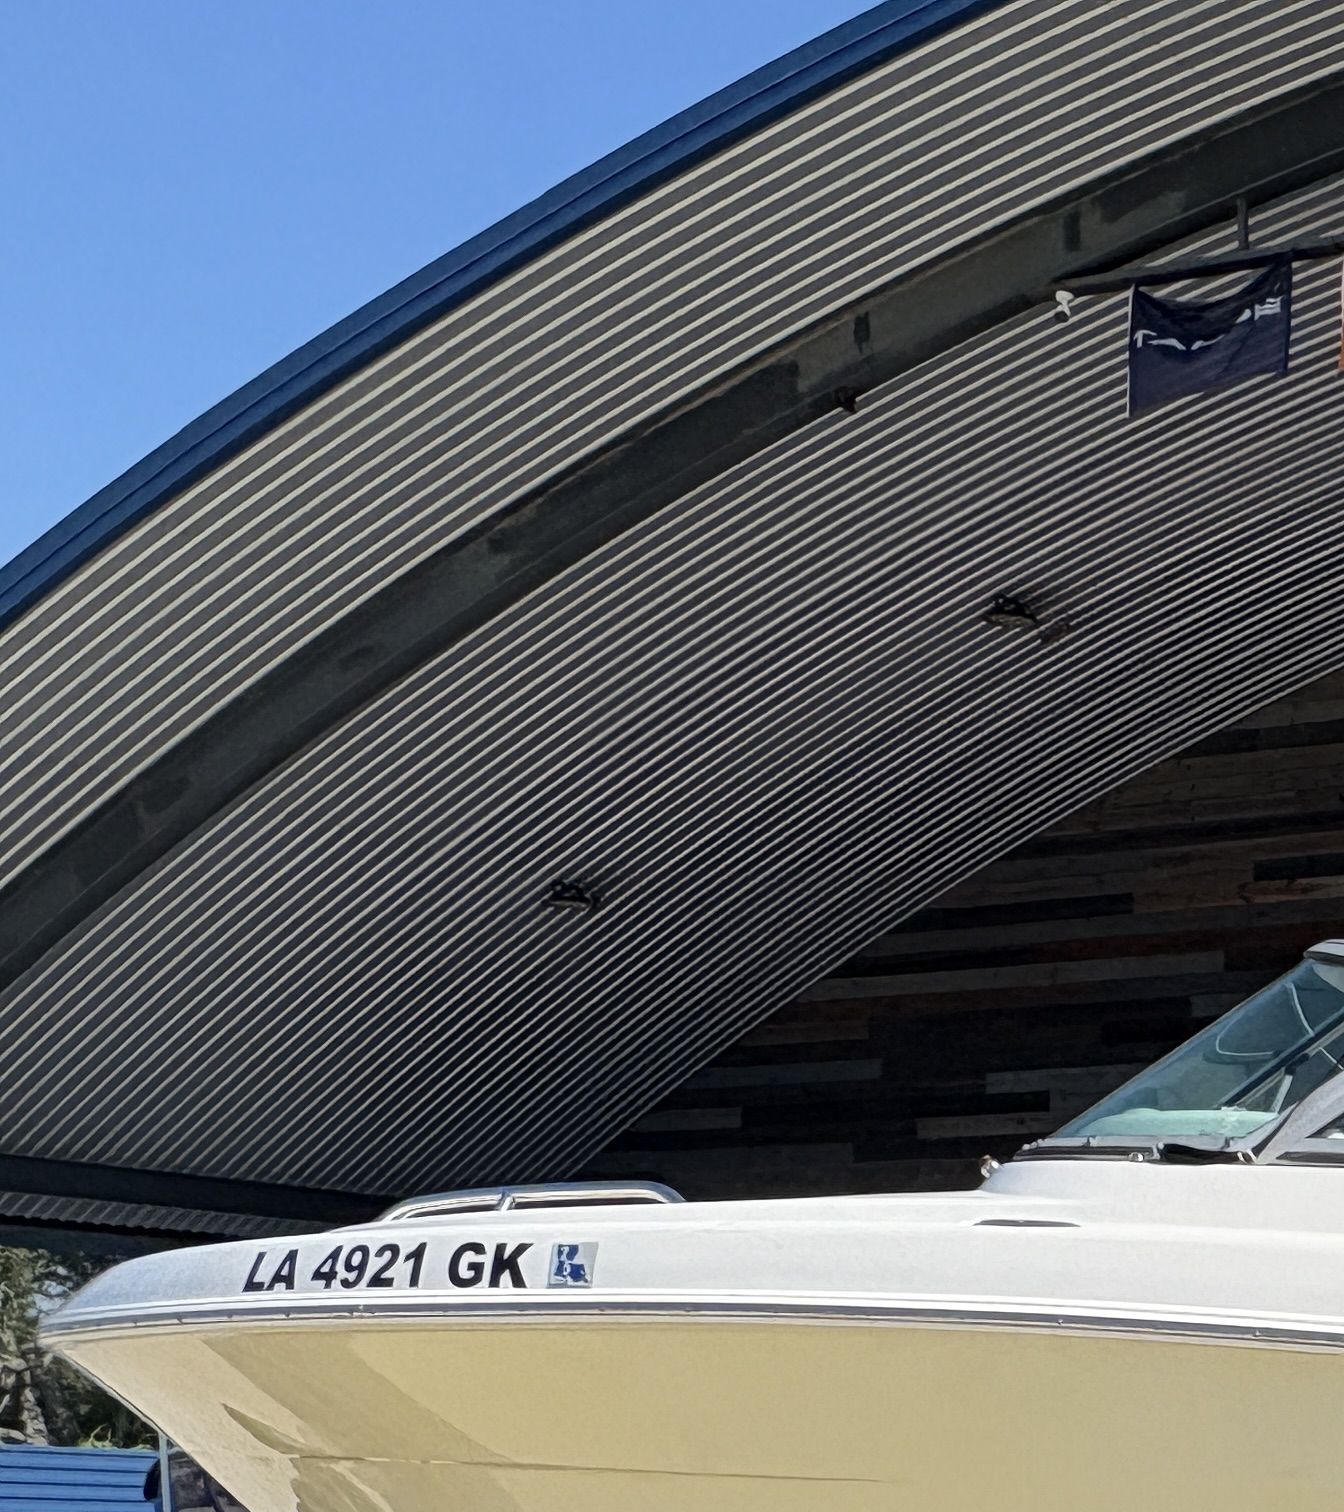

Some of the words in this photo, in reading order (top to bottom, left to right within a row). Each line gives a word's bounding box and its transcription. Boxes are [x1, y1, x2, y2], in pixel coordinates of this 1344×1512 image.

[242, 1249, 298, 1293] LA
[311, 1241, 428, 1290] 4921
[448, 1241, 533, 1289] GK
